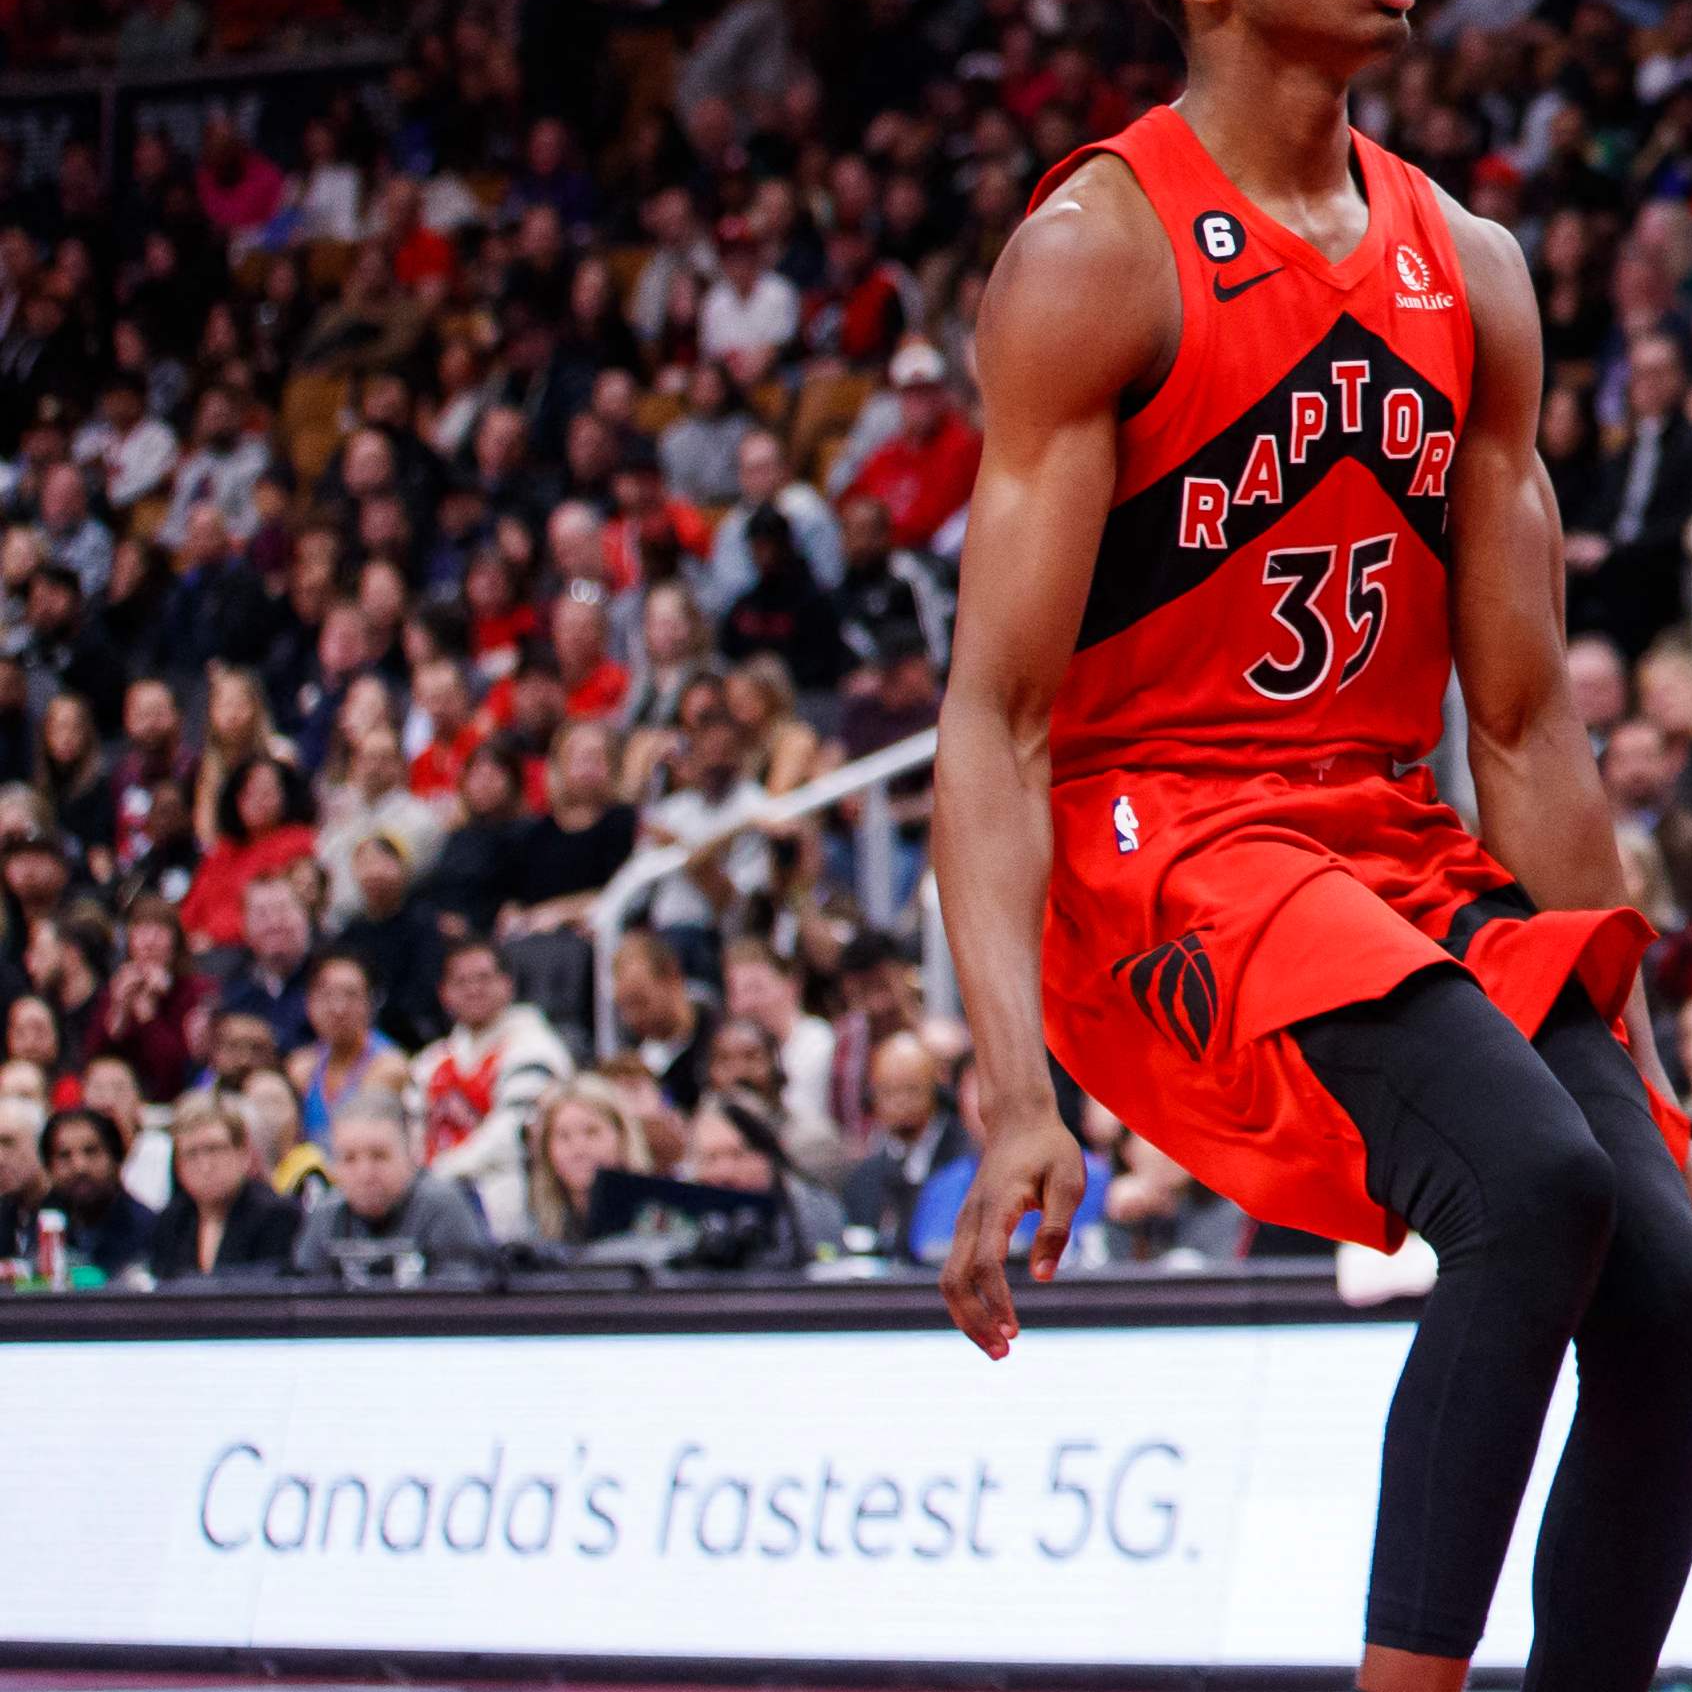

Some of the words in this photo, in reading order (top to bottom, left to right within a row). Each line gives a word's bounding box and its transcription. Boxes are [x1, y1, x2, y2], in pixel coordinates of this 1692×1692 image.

[1201, 216, 1236, 257] 6
[1178, 360, 1456, 549] RAPTOR
[1242, 533, 1398, 701] 35
[199, 1440, 622, 1560] Canada's
[656, 1442, 1003, 1562] fastest
[1033, 1438, 1202, 1564] 5G.
